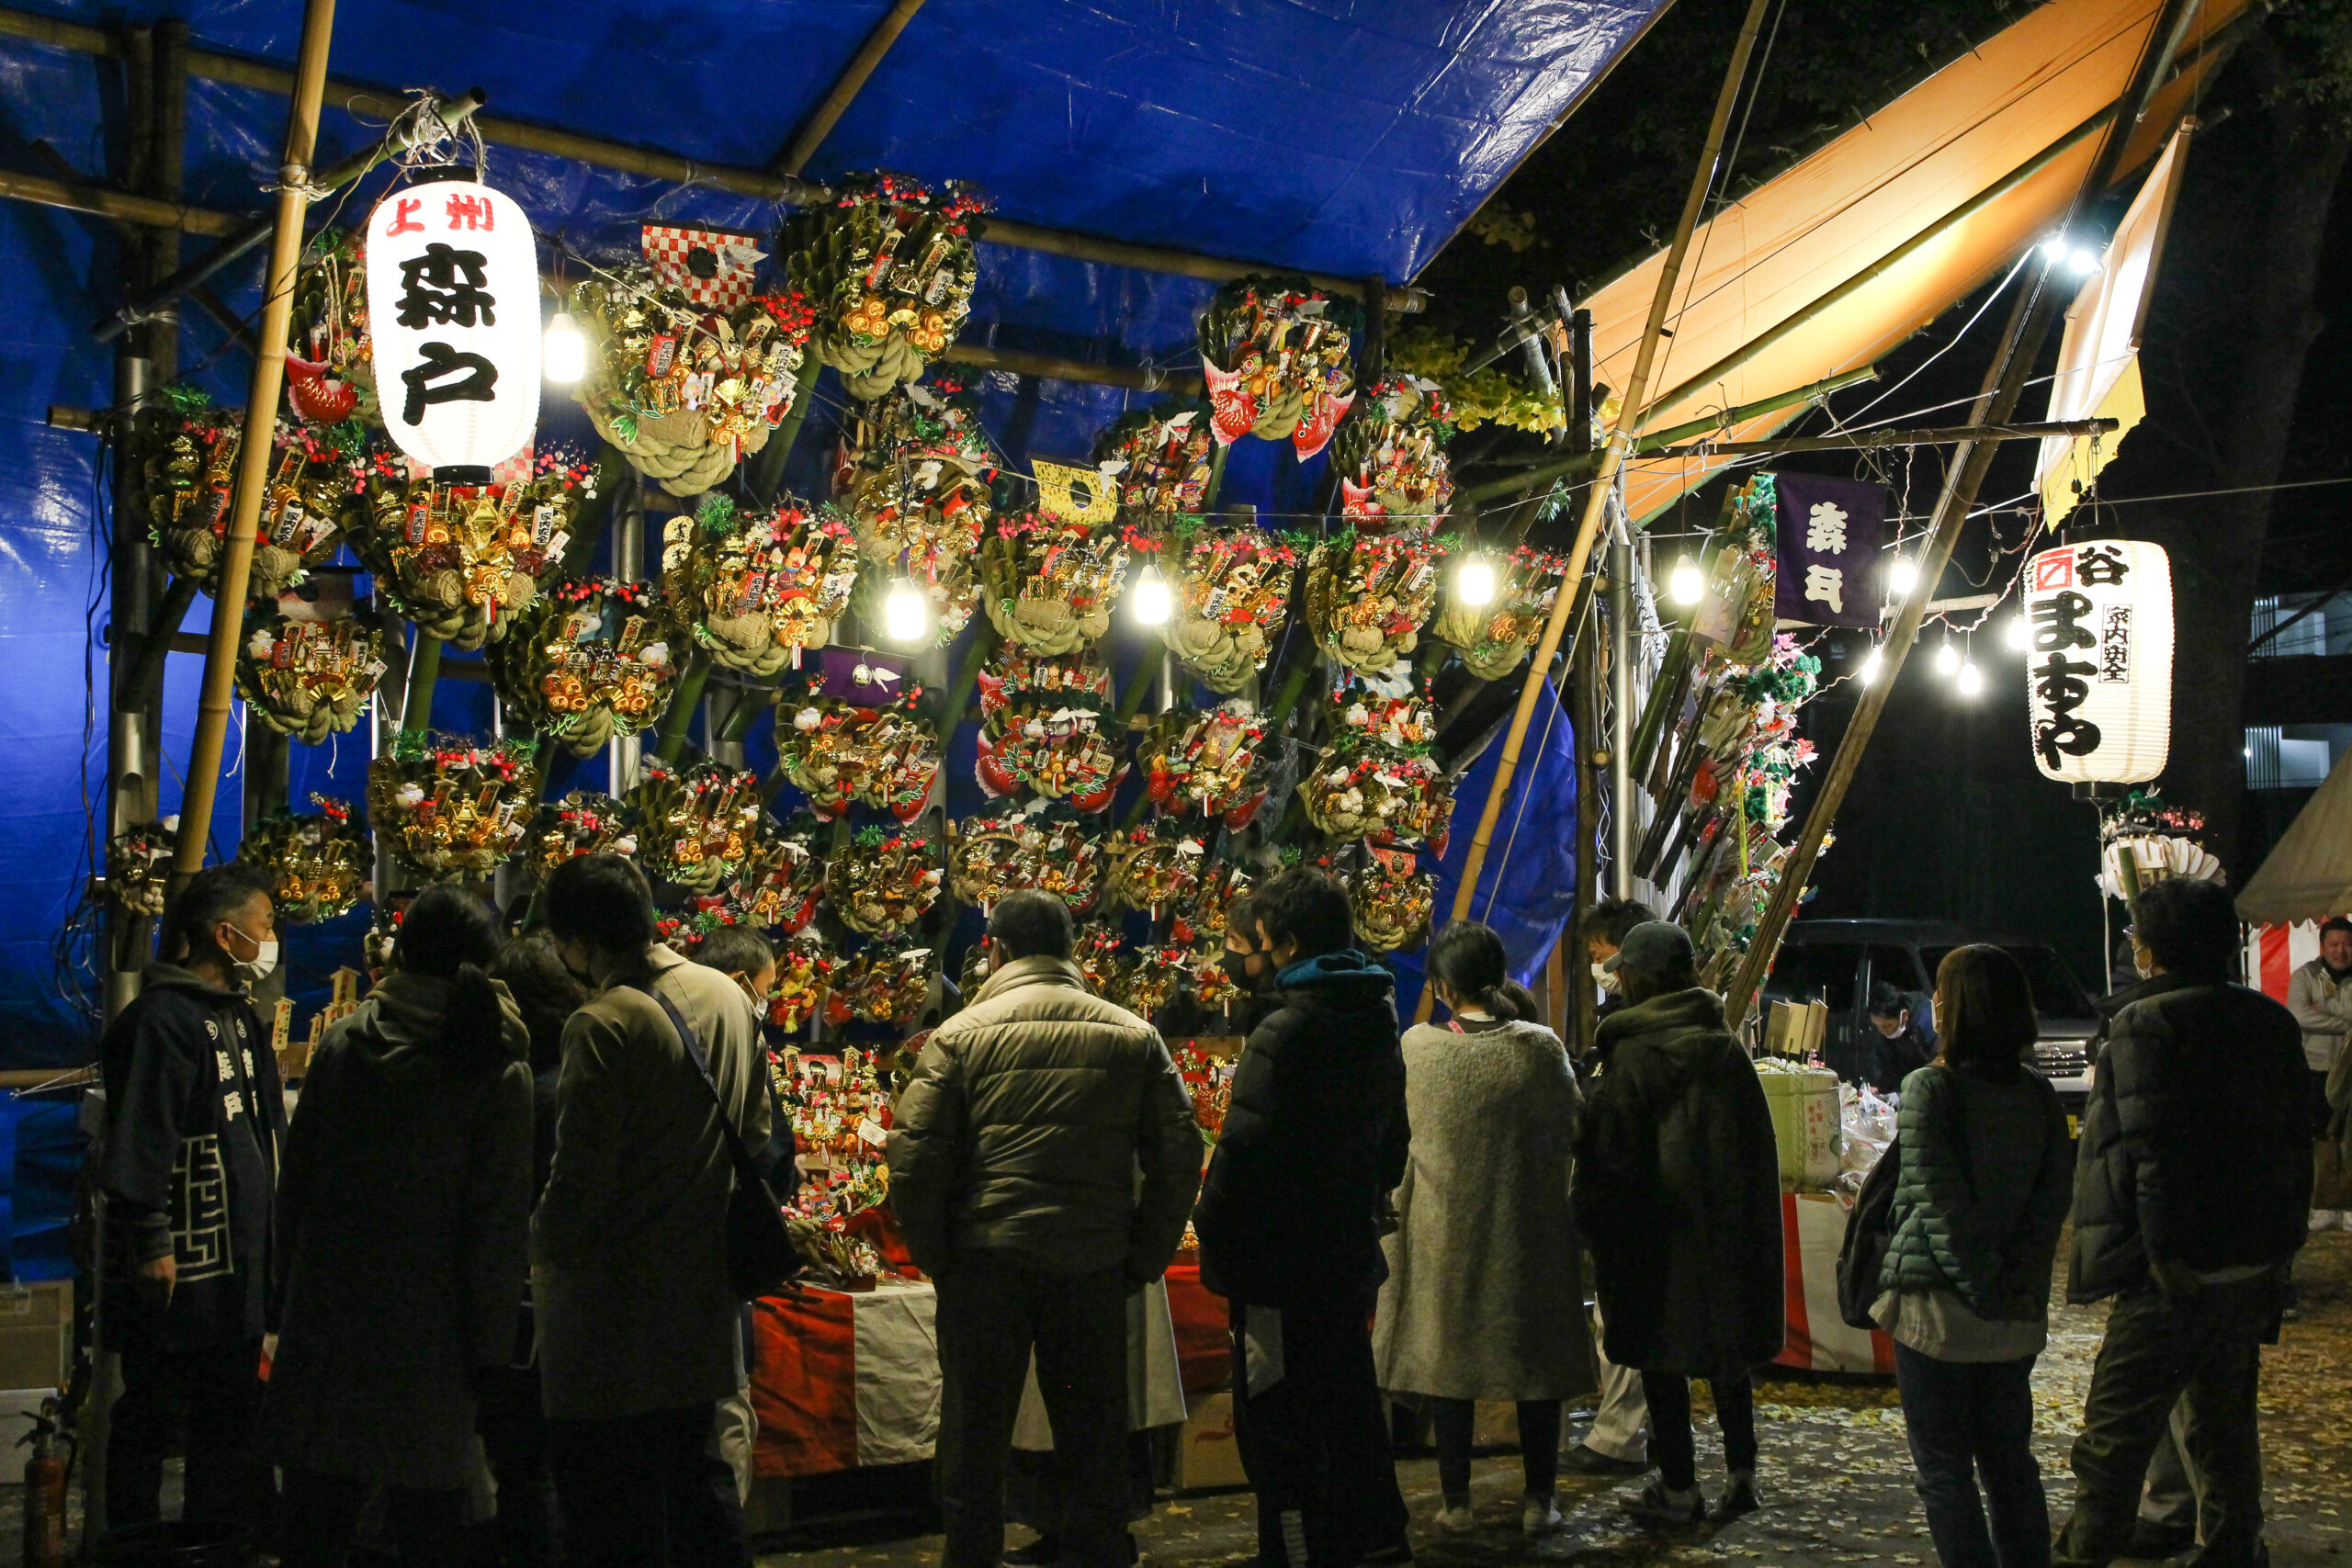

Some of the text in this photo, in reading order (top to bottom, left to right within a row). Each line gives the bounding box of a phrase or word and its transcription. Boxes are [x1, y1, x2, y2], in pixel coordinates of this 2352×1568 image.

[386, 194, 494, 236] 上州
[395, 243, 498, 425] 森戸
[1804, 502, 1848, 614] 森戸
[2076, 546, 2130, 587] 谷
